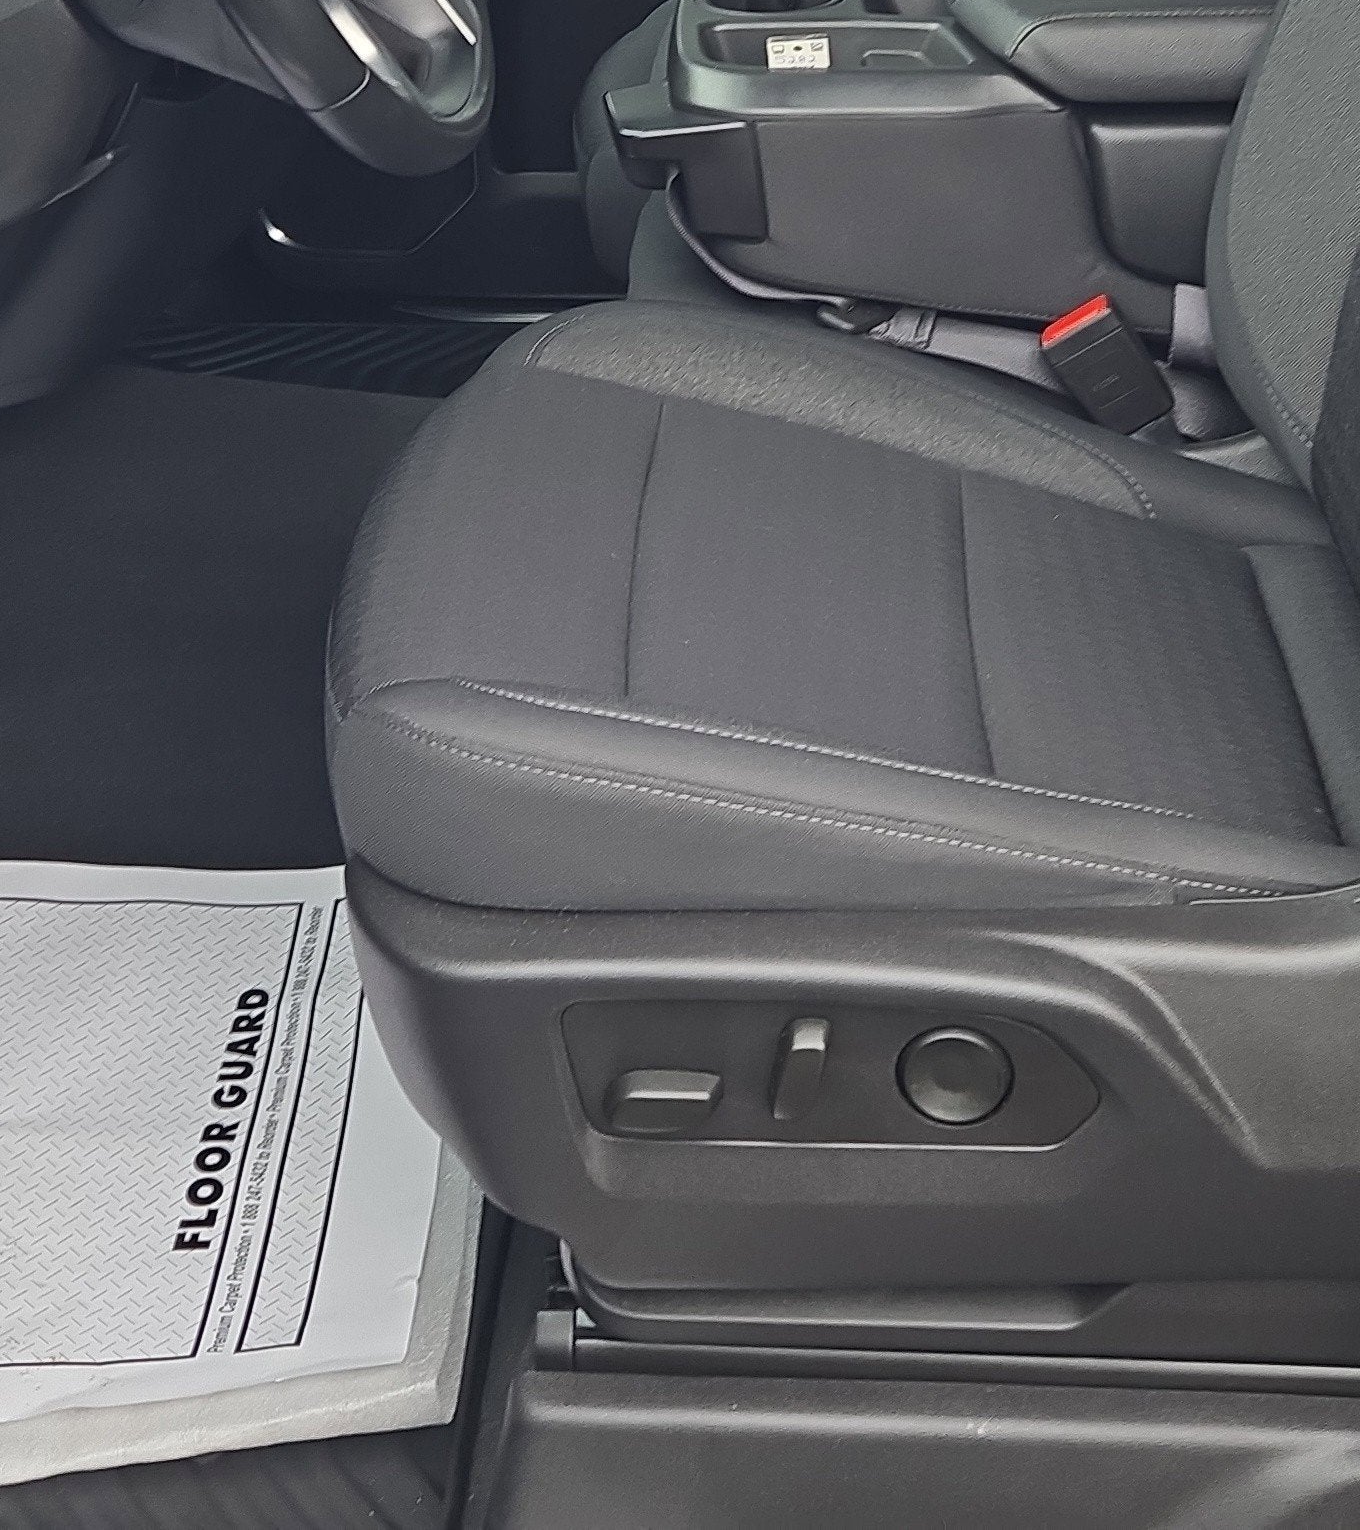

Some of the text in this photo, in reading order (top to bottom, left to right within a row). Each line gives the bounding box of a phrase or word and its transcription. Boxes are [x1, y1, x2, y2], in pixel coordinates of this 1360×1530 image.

[172, 988, 269, 1251] FLOOR GUARD
[227, 1235, 253, 1281] Protection
[219, 1283, 242, 1313] Carpet
[206, 1314, 233, 1353] Premium
